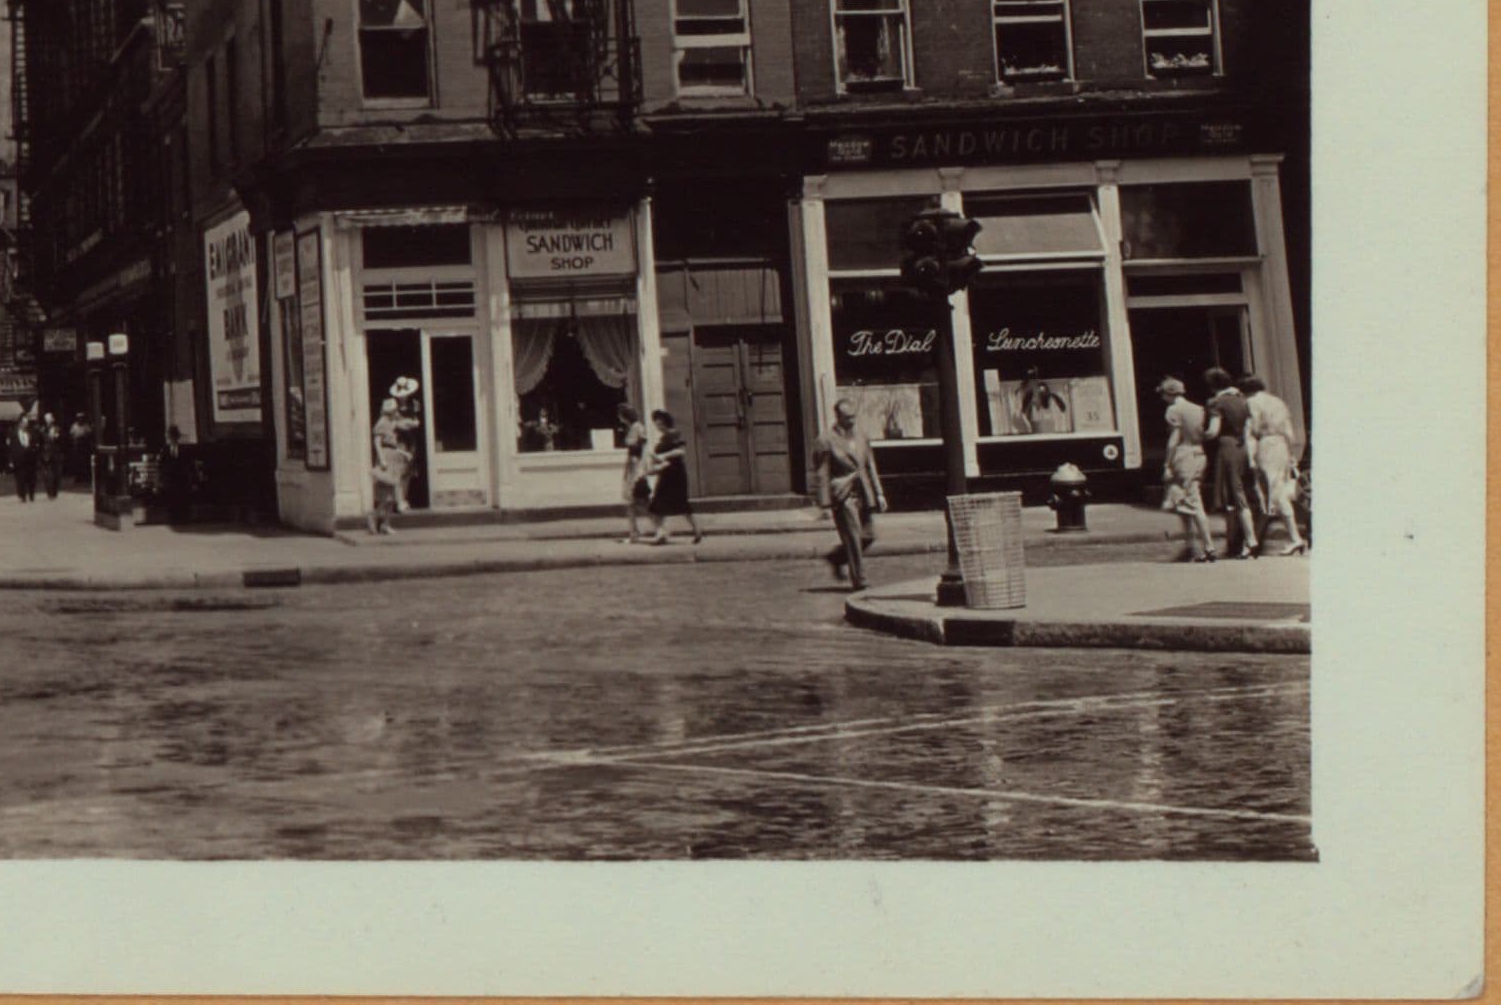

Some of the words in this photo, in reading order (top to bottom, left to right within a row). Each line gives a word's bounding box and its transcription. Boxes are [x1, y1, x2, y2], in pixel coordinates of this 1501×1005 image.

[891, 127, 1069, 159] SANDWICH
[1087, 122, 1179, 149] SHOP
[526, 232, 614, 254] SANDWICH
[550, 255, 595, 270] SHOP
[847, 330, 883, 356] The
[883, 328, 937, 355] Dial
[985, 326, 1101, 352] Luncheonette
